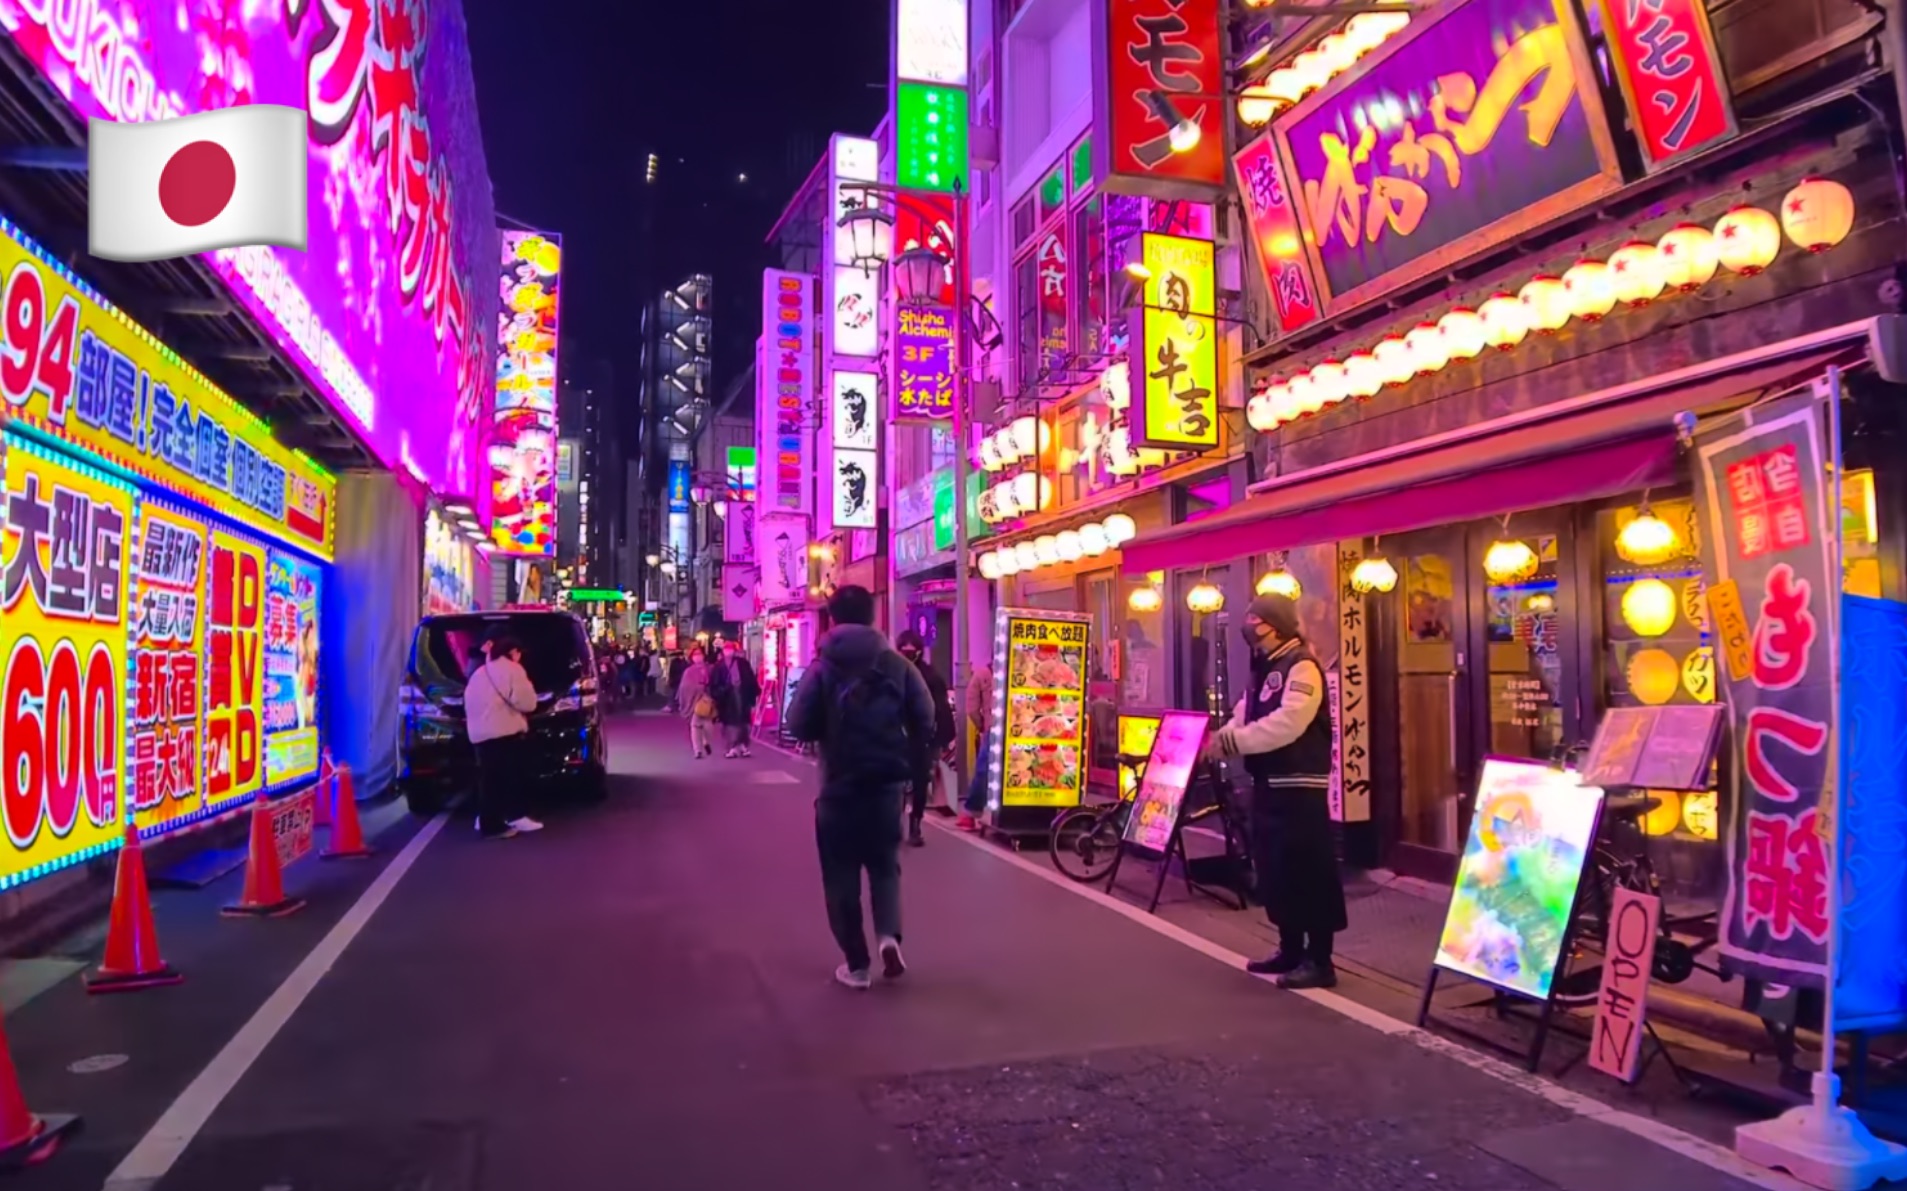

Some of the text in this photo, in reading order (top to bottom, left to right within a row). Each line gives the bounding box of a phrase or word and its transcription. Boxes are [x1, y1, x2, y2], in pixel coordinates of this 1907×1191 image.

[1128, 0, 1206, 169] モン
[1246, 156, 1311, 317] 焼肉
[899, 309, 945, 326] Shisha
[899, 325, 954, 339] Alchemi
[902, 346, 935, 361] 3F
[1149, 271, 1211, 436] 肉の牛吉
[899, 389, 954, 407] 水たば
[900, 370, 953, 387] シーシ
[3, 472, 124, 622] 大型店
[141, 518, 201, 587] 最新作
[138, 588, 196, 643] 大量入荷
[1012, 623, 1085, 643] 焼肉食べ放題
[136, 650, 198, 724] 新宿
[235, 550, 259, 786] DVD
[2, 636, 118, 848] 600円
[134, 727, 196, 812] 最大級
[1600, 899, 1650, 1073] OPEN
